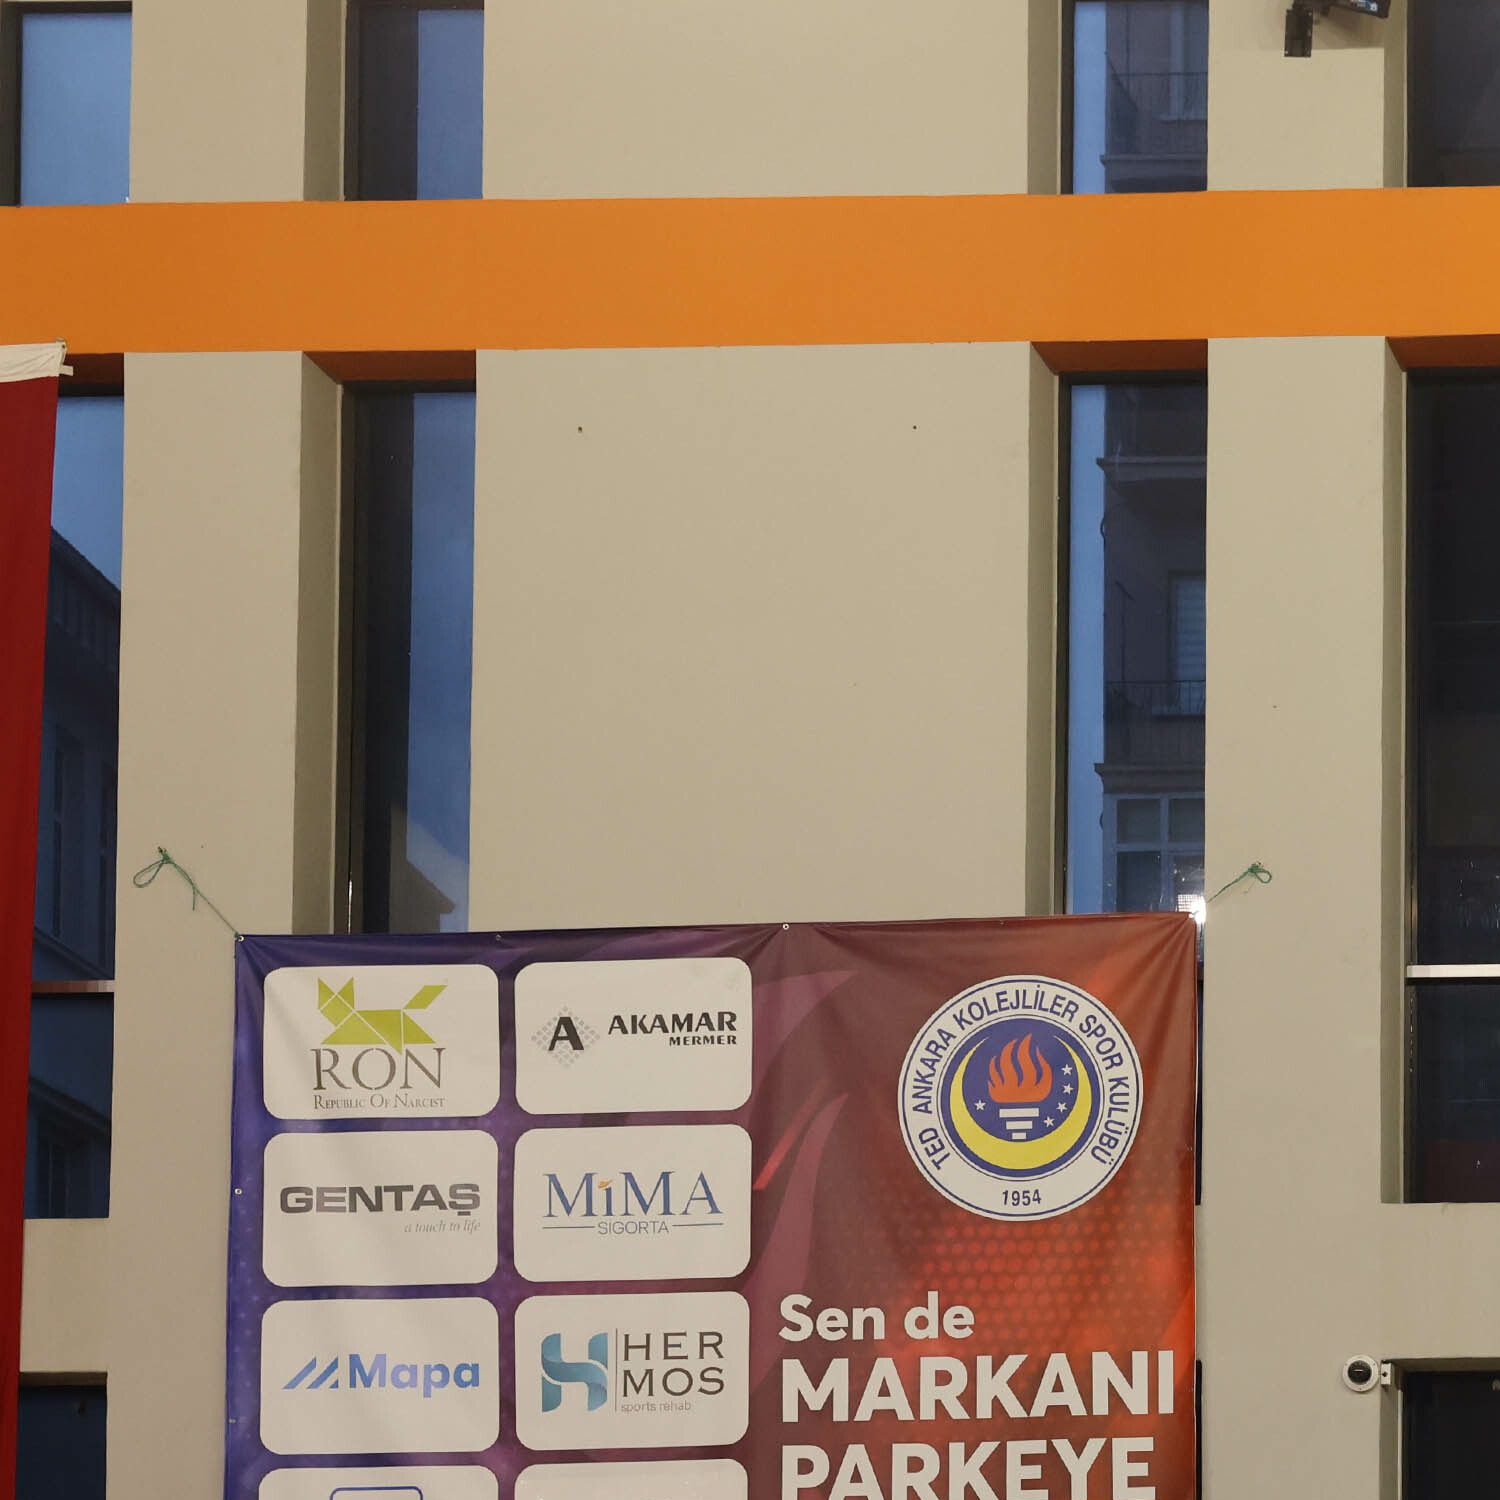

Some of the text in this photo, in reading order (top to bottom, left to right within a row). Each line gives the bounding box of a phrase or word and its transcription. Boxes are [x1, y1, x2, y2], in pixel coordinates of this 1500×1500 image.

[607, 1011, 738, 1035] AKAMAR
[669, 1034, 738, 1047] MERMER
[311, 1047, 446, 1091] RON
[911, 984, 1130, 1171] TED ANKARA KOLEJLİLER SPOR KULÜBÜ
[279, 1183, 481, 1217] GENTAŞ
[1001, 1189, 1042, 1207] 1954
[415, 1220, 446, 1233] touch
[449, 1221, 460, 1232] to
[463, 1219, 481, 1236] life
[778, 1291, 975, 1342] Sen de
[623, 1331, 725, 1361] HER
[348, 1353, 480, 1398] Mapa
[623, 1367, 725, 1397] MOS
[781, 1350, 1174, 1422] MARKANI
[621, 1400, 692, 1412] sports rehab
